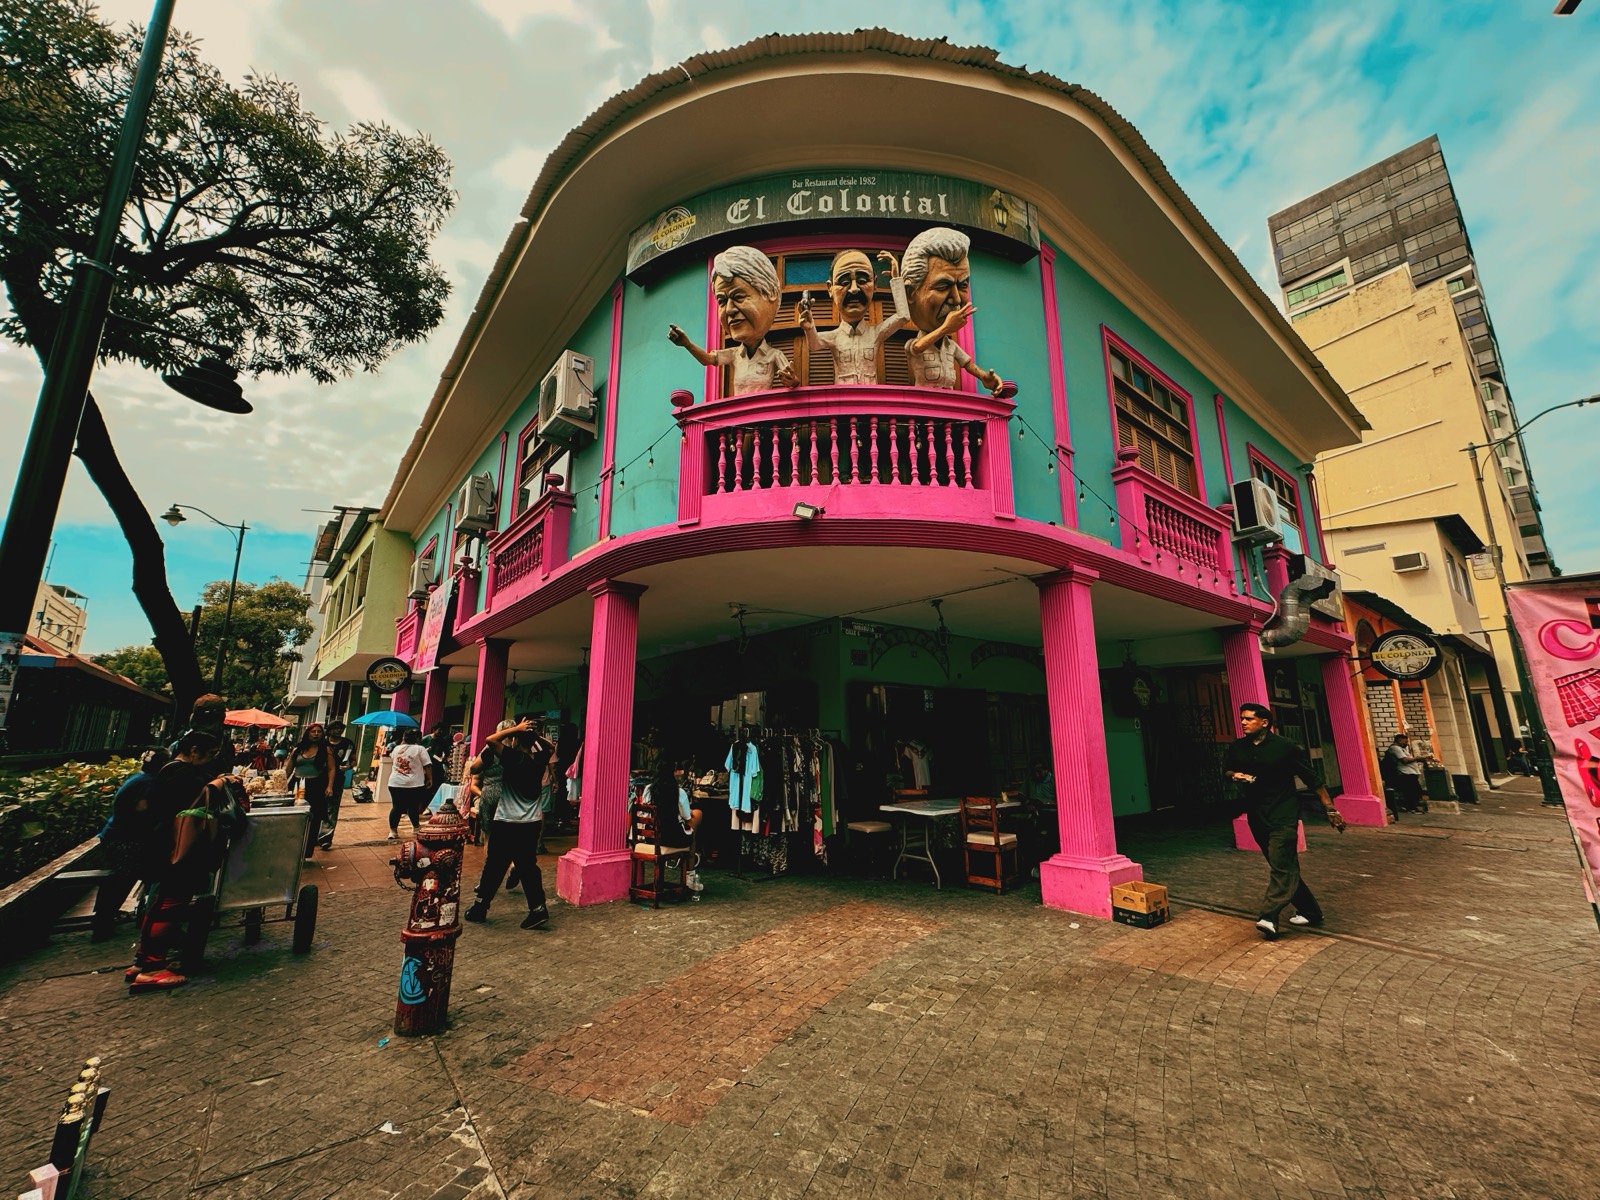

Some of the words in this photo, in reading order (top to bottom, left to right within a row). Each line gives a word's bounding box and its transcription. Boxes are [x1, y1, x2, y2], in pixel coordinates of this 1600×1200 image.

[792, 179, 803, 188] Bar
[804, 178, 838, 187] Restaurant
[839, 177, 857, 186] desde
[726, 195, 766, 224] El
[786, 188, 950, 217] Colonial
[660, 218, 694, 237] COLONIAL
[1538, 618, 1600, 662] C
[1387, 649, 1434, 659] COLONIAL
